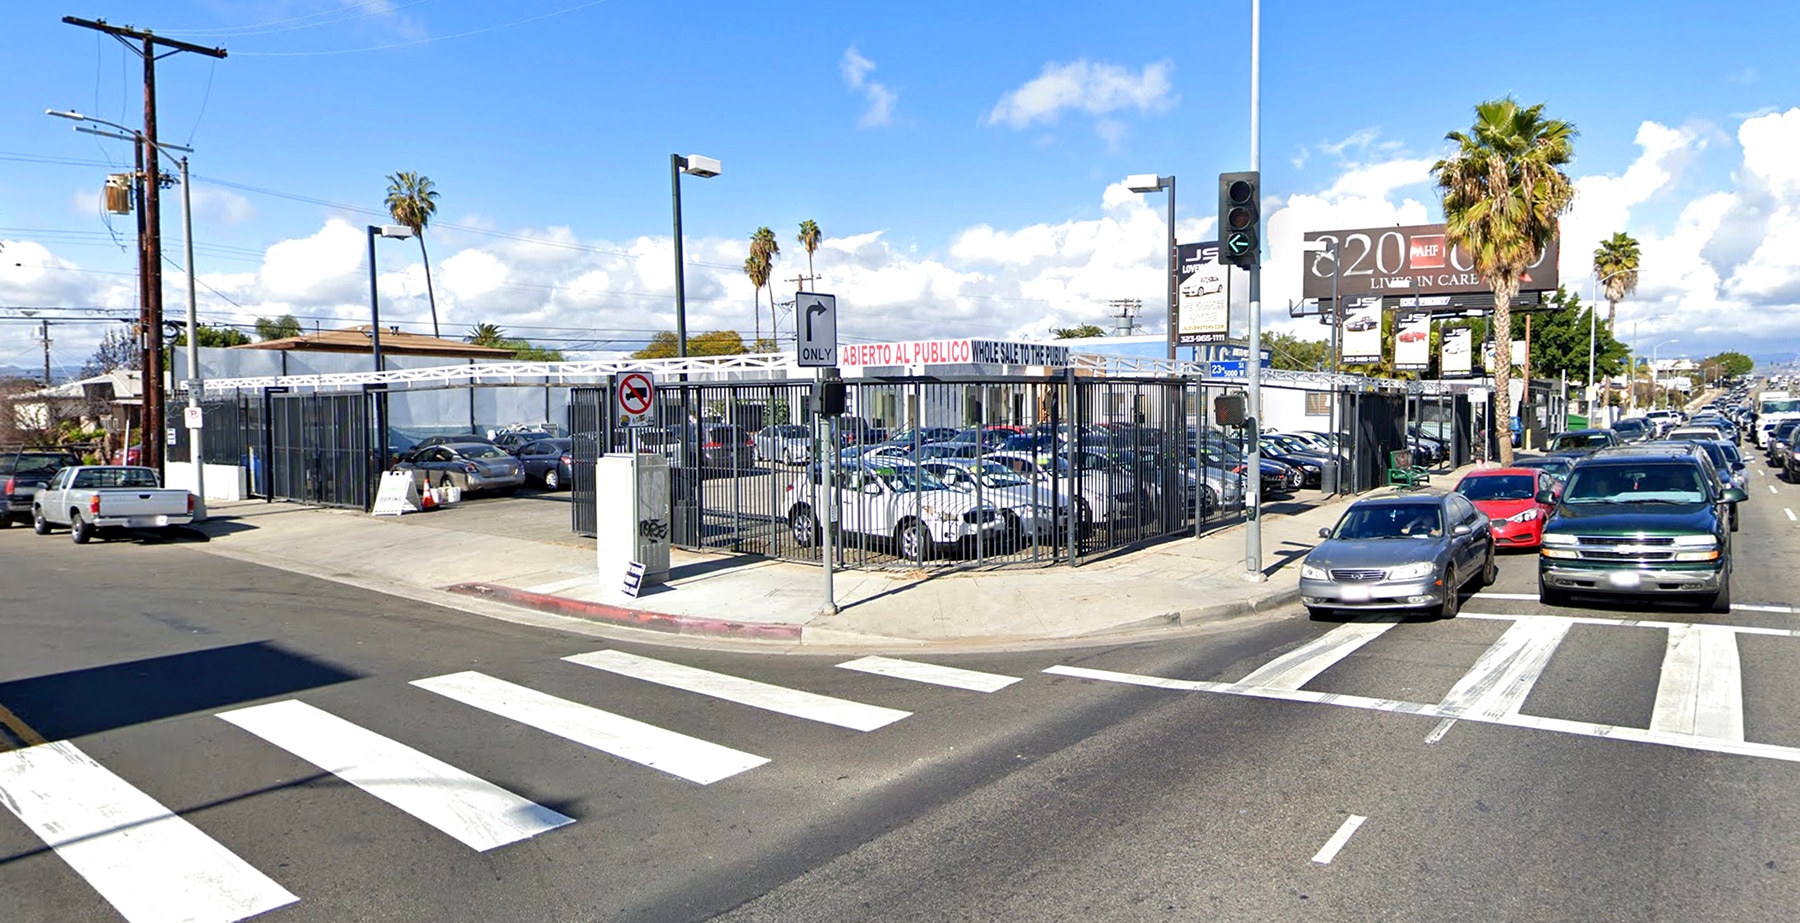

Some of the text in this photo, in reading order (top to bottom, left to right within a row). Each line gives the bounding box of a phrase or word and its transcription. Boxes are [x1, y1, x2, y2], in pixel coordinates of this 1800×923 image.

[1185, 247, 1219, 263] JS
[1416, 243, 1439, 257] AHF
[1416, 275, 1433, 287] IN
[1437, 273, 1479, 286] CARE
[1348, 297, 1377, 307] JS
[1180, 334, 1225, 343] 323-965-1111
[803, 348, 831, 360] ONLY
[843, 340, 969, 366] ABIERTO AL PUBLICO
[971, 340, 1069, 366] WHOLE SALE TO THE PUBLIC
[1224, 369, 1238, 377] 5000
